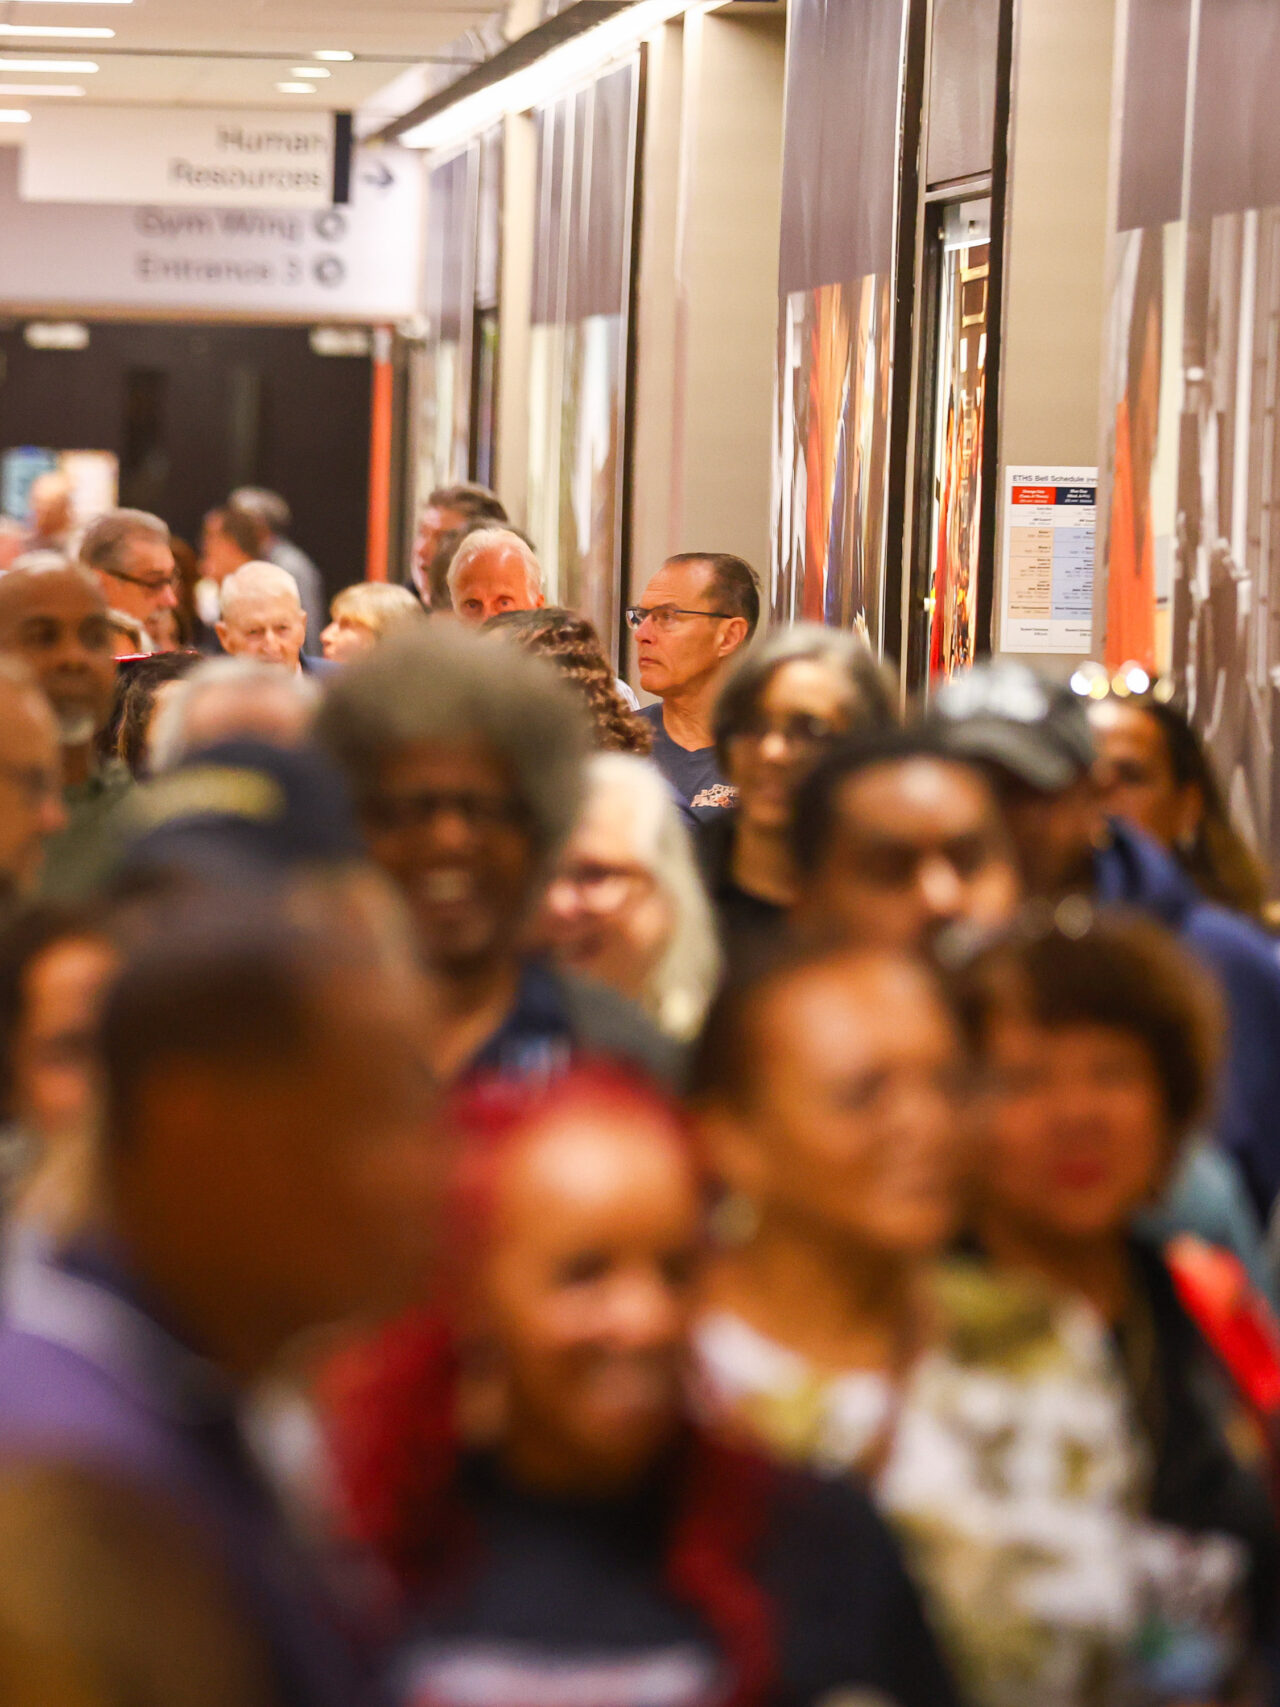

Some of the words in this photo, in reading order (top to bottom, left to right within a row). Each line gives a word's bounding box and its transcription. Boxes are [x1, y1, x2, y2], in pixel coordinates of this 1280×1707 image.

[218, 127, 327, 151] Human
[170, 157, 323, 189] Resources
[135, 207, 210, 241] Gym
[223, 209, 301, 246] Wing
[135, 250, 271, 281] Entrance
[1012, 474, 1033, 482] ETHS
[1035, 474, 1049, 482] Bell
[1050, 475, 1085, 483] Schedule
